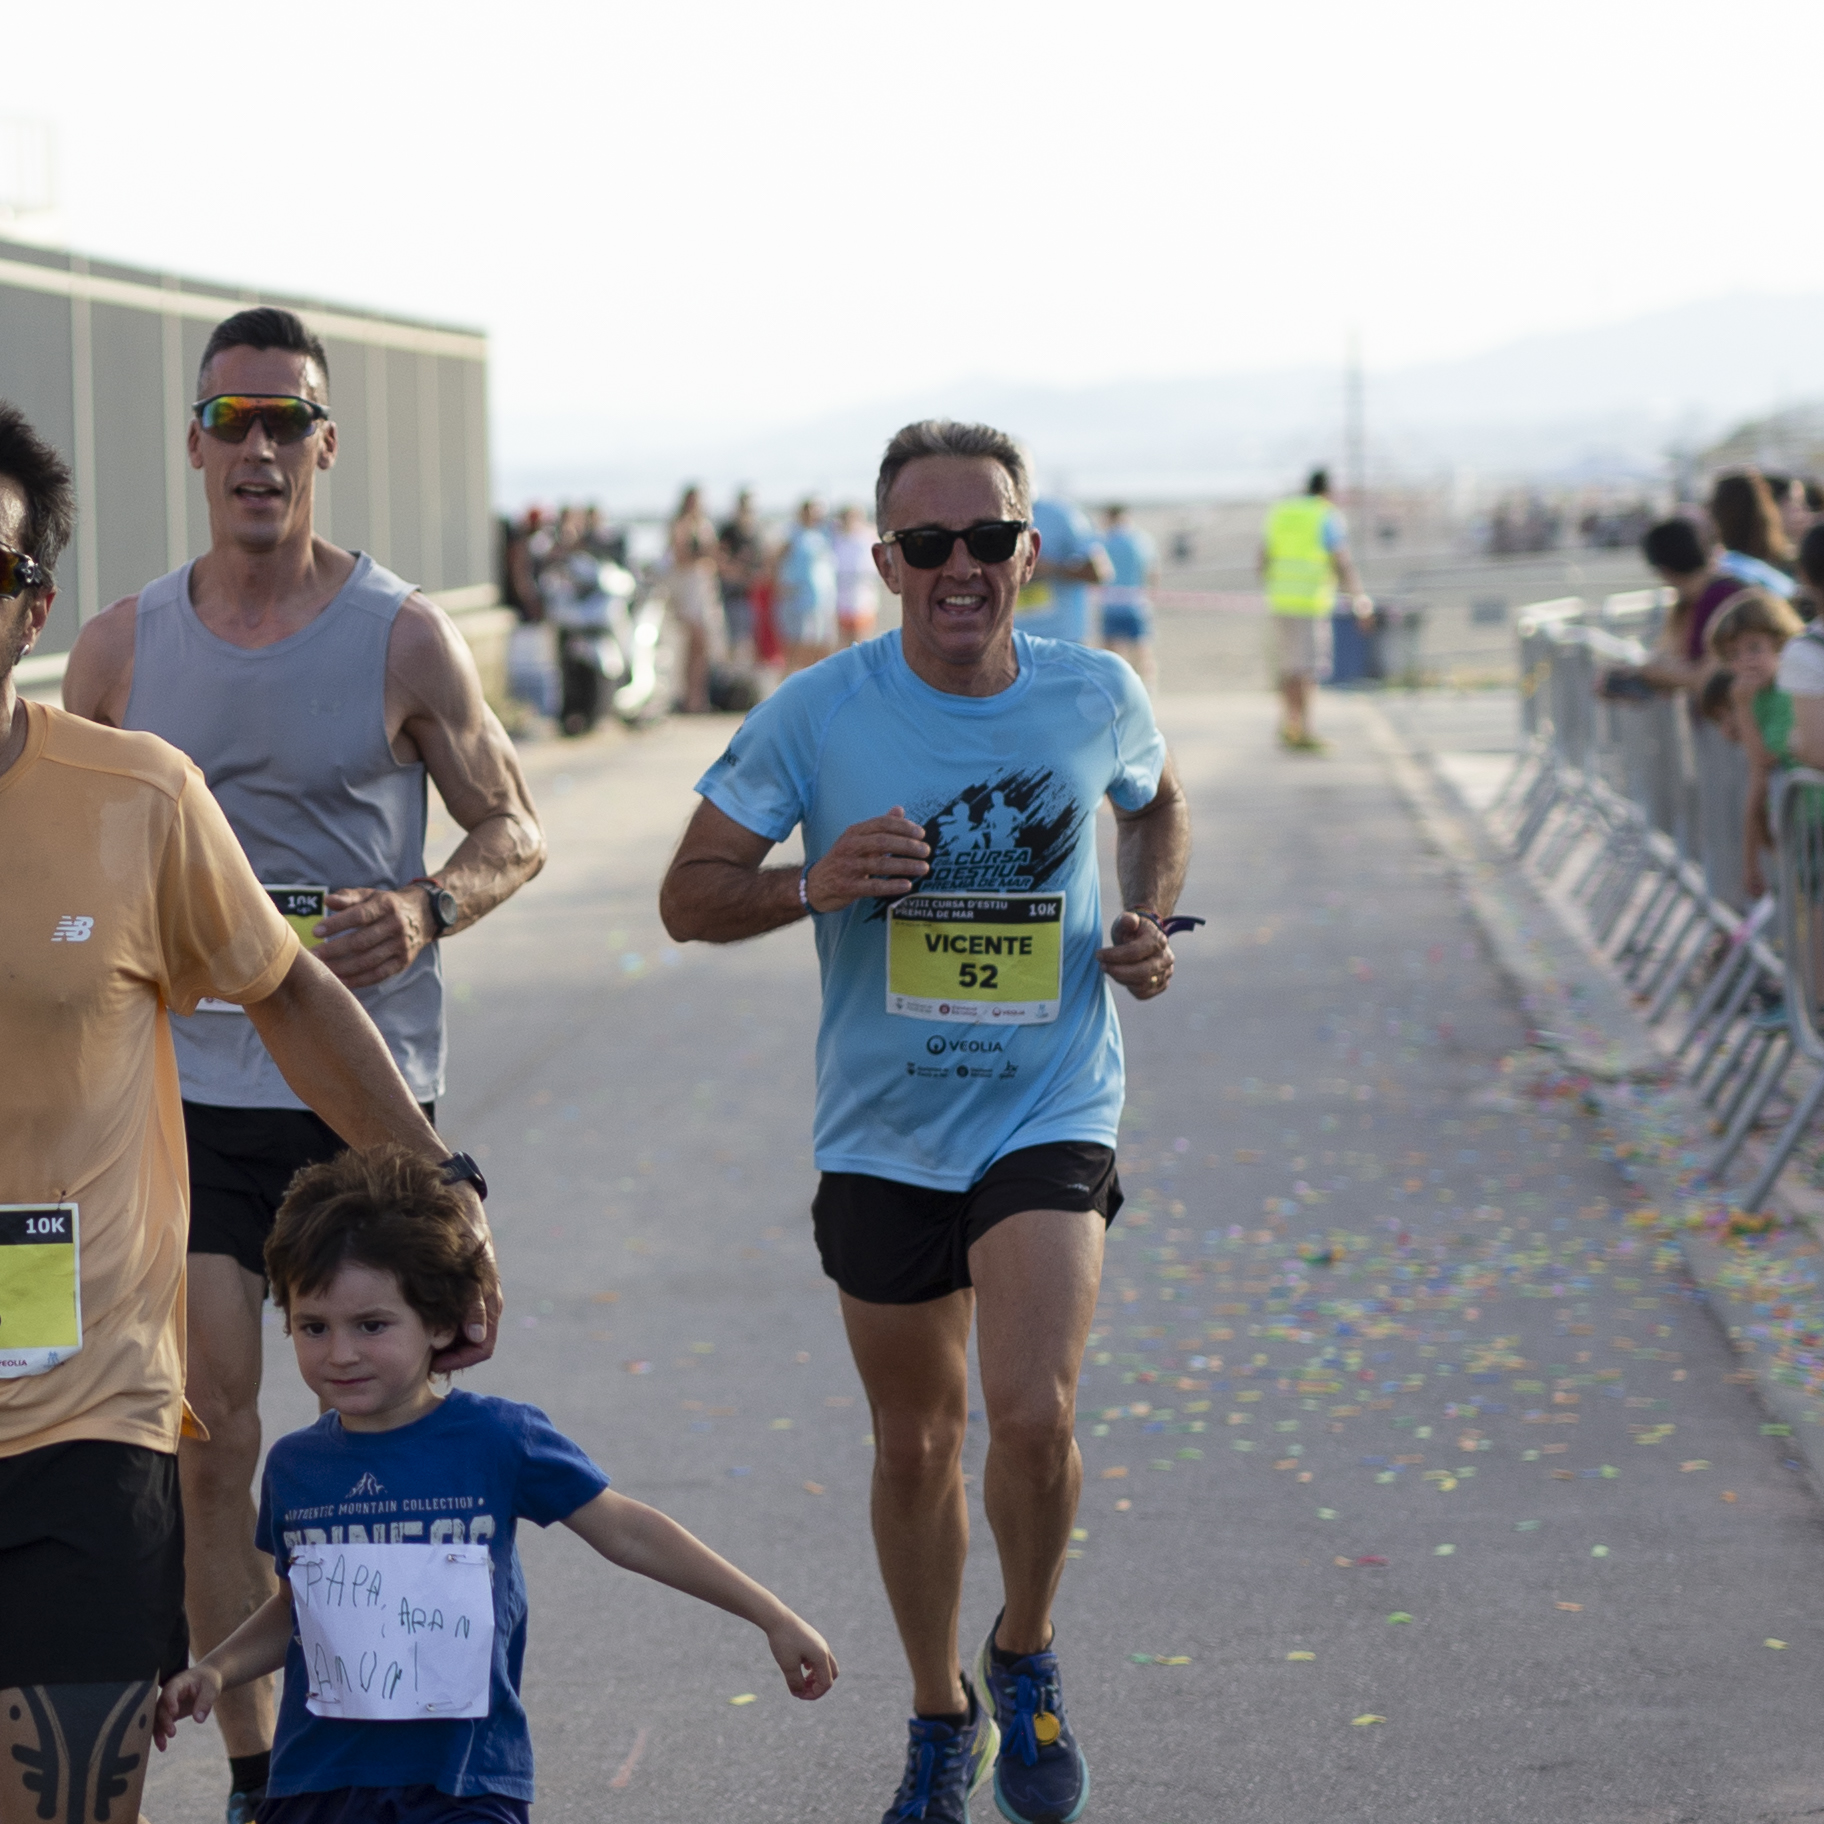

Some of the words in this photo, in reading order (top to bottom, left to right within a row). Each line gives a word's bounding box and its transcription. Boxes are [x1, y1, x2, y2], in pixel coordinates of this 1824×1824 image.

[955, 849, 1030, 865] CURSA
[998, 877, 1031, 888] MAR
[932, 899, 965, 909] CURSA
[967, 900, 1008, 910] D'ESTIU
[1028, 902, 1058, 917] 10K
[936, 909, 950, 919] DE
[952, 910, 974, 919] MAR
[925, 933, 1033, 955] VICENTE
[958, 962, 999, 989] 52
[949, 1040, 1004, 1053] VEOLIA
[25, 1217, 65, 1234] 10K
[338, 1499, 398, 1515] MOUNTAIN
[402, 1496, 474, 1512] COLLECTION
